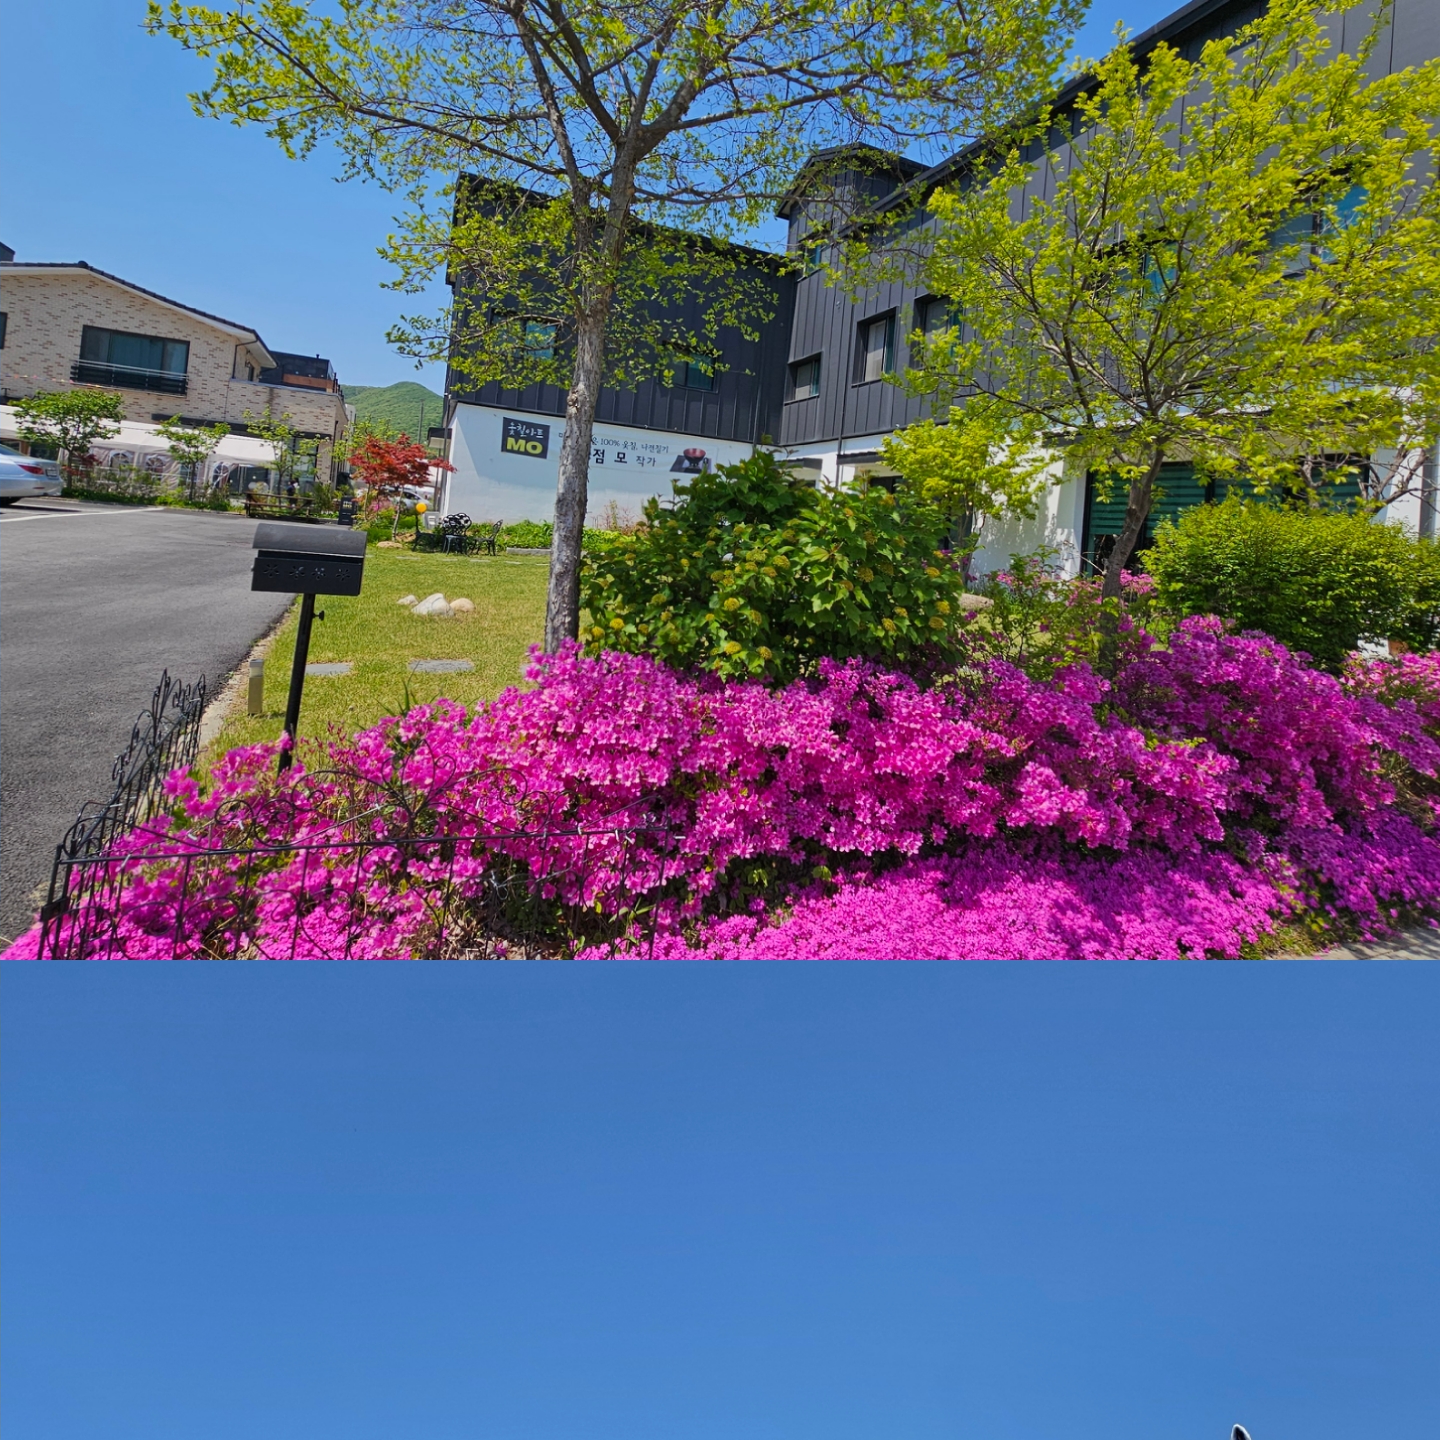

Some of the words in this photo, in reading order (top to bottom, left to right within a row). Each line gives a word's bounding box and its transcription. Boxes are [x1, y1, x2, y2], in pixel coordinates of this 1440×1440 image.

[506, 436, 543, 454] MO
[600, 438, 620, 447] 100%
[614, 452, 627, 464] 모
[636, 456, 657, 467] 작가
